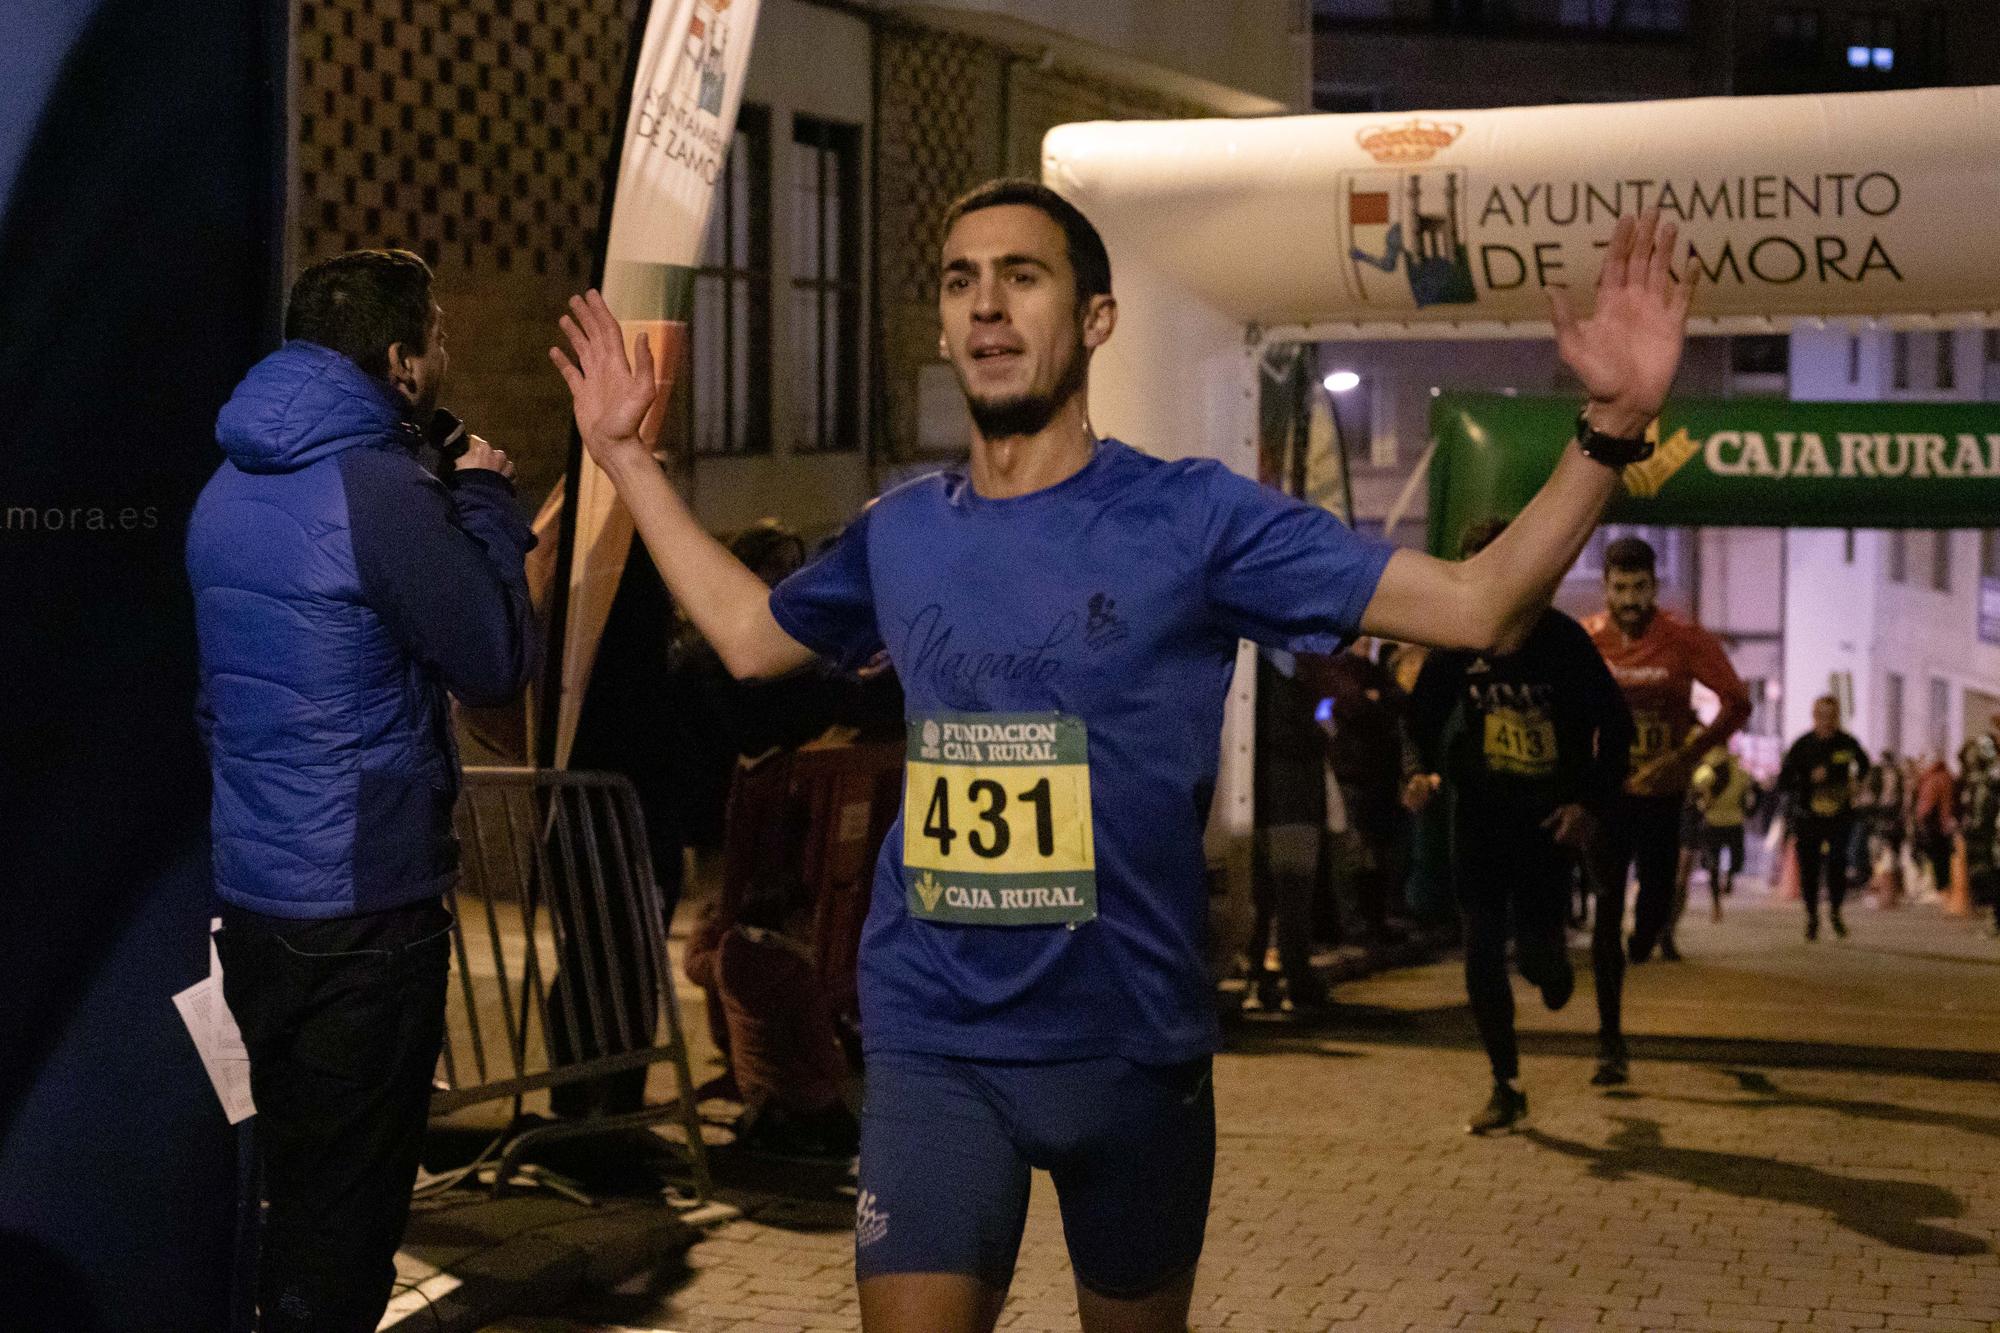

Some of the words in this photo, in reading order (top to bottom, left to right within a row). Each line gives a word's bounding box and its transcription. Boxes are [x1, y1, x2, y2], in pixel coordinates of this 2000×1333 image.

[637, 111, 658, 148] DE
[1480, 172, 1900, 227] AYUNTAMIENTO
[1481, 242, 1568, 290] DE
[1592, 235, 1904, 288] MORA
[1704, 431, 1834, 478] CAJA
[0, 506, 159, 531] mora.es
[943, 723, 1057, 743] FUNDACION
[1495, 724, 1545, 757] 413
[944, 743, 983, 761] CAJA
[988, 743, 1057, 761] RURAL
[922, 776, 1054, 858] 431
[945, 886, 995, 909] CAJA
[1000, 886, 1084, 909] RURAL
